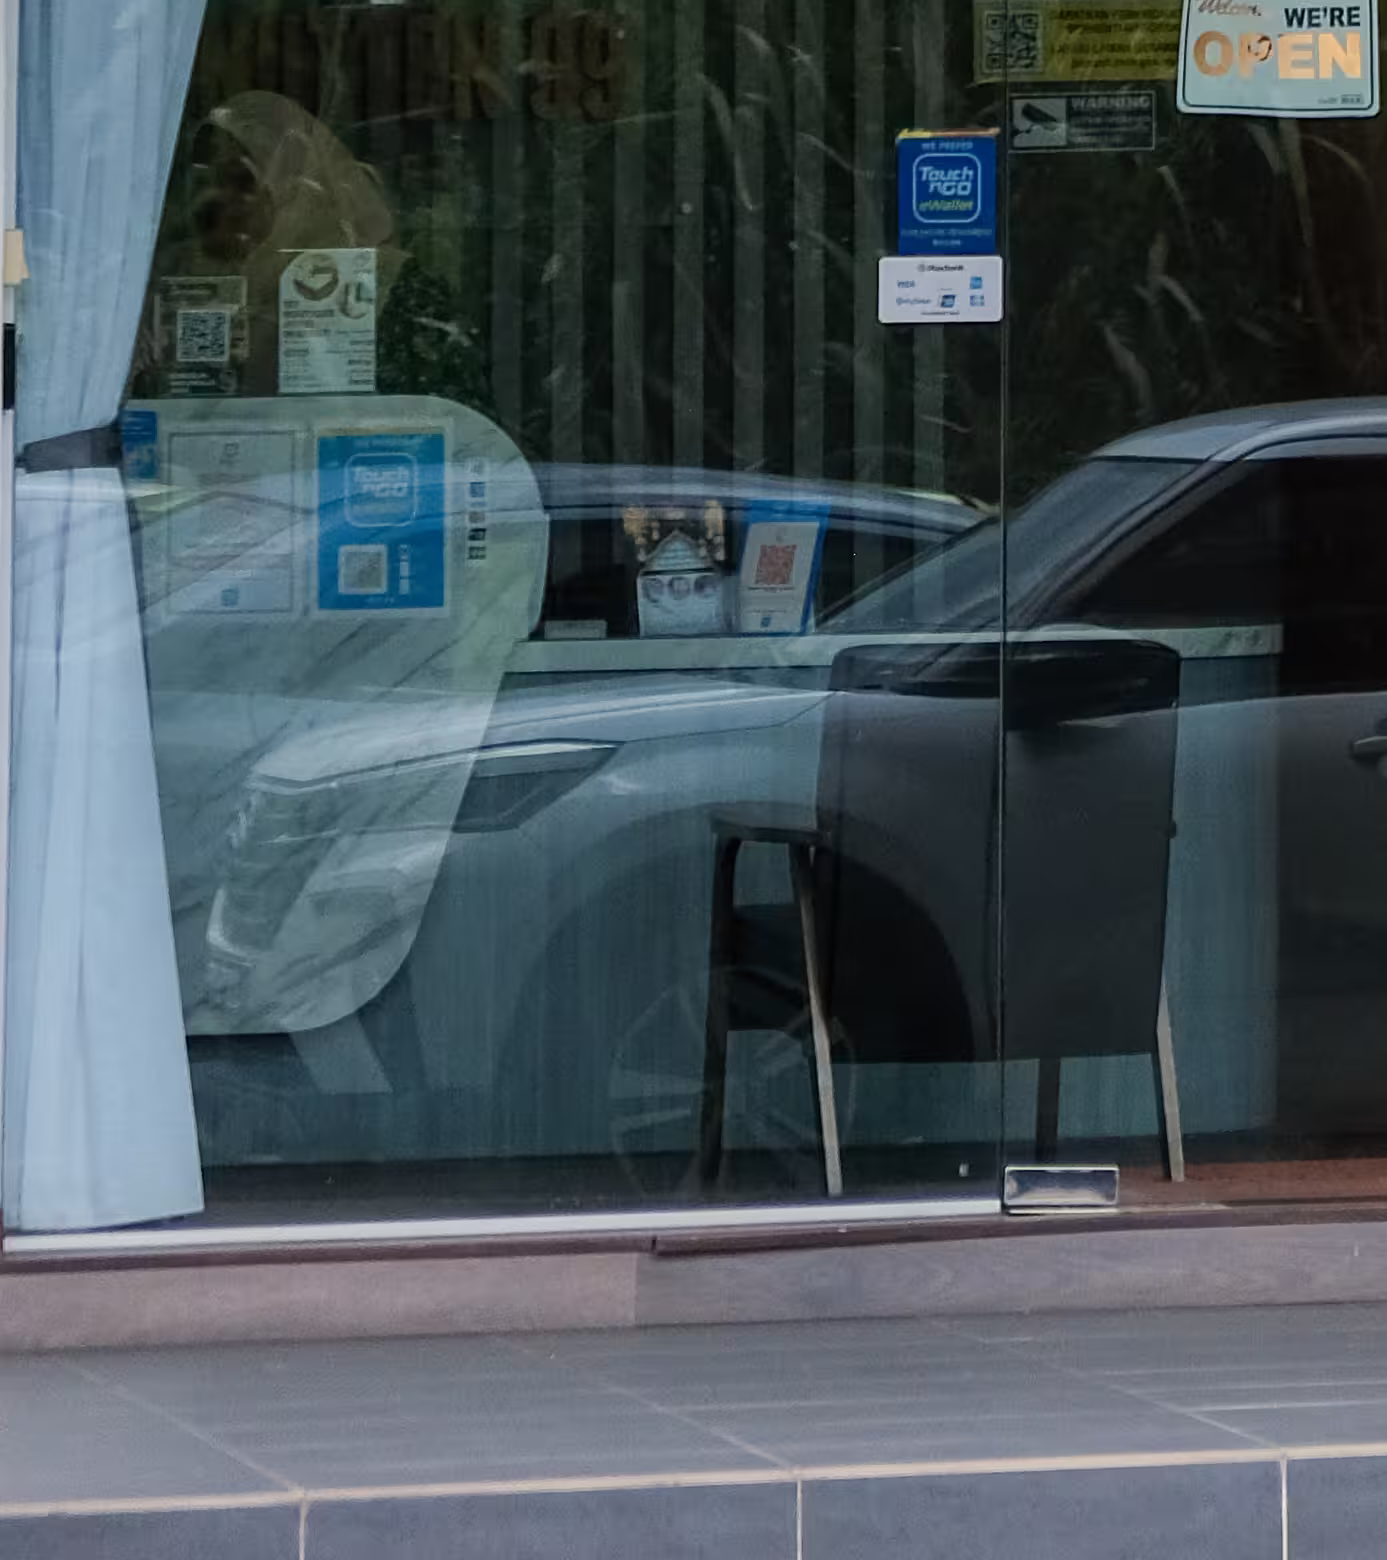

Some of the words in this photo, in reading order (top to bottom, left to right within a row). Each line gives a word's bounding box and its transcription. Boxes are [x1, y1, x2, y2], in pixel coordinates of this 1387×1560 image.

[1284, 6, 1361, 28] WE'RE
[1193, 29, 1362, 80] OPEN
[918, 166, 974, 182] Touch
